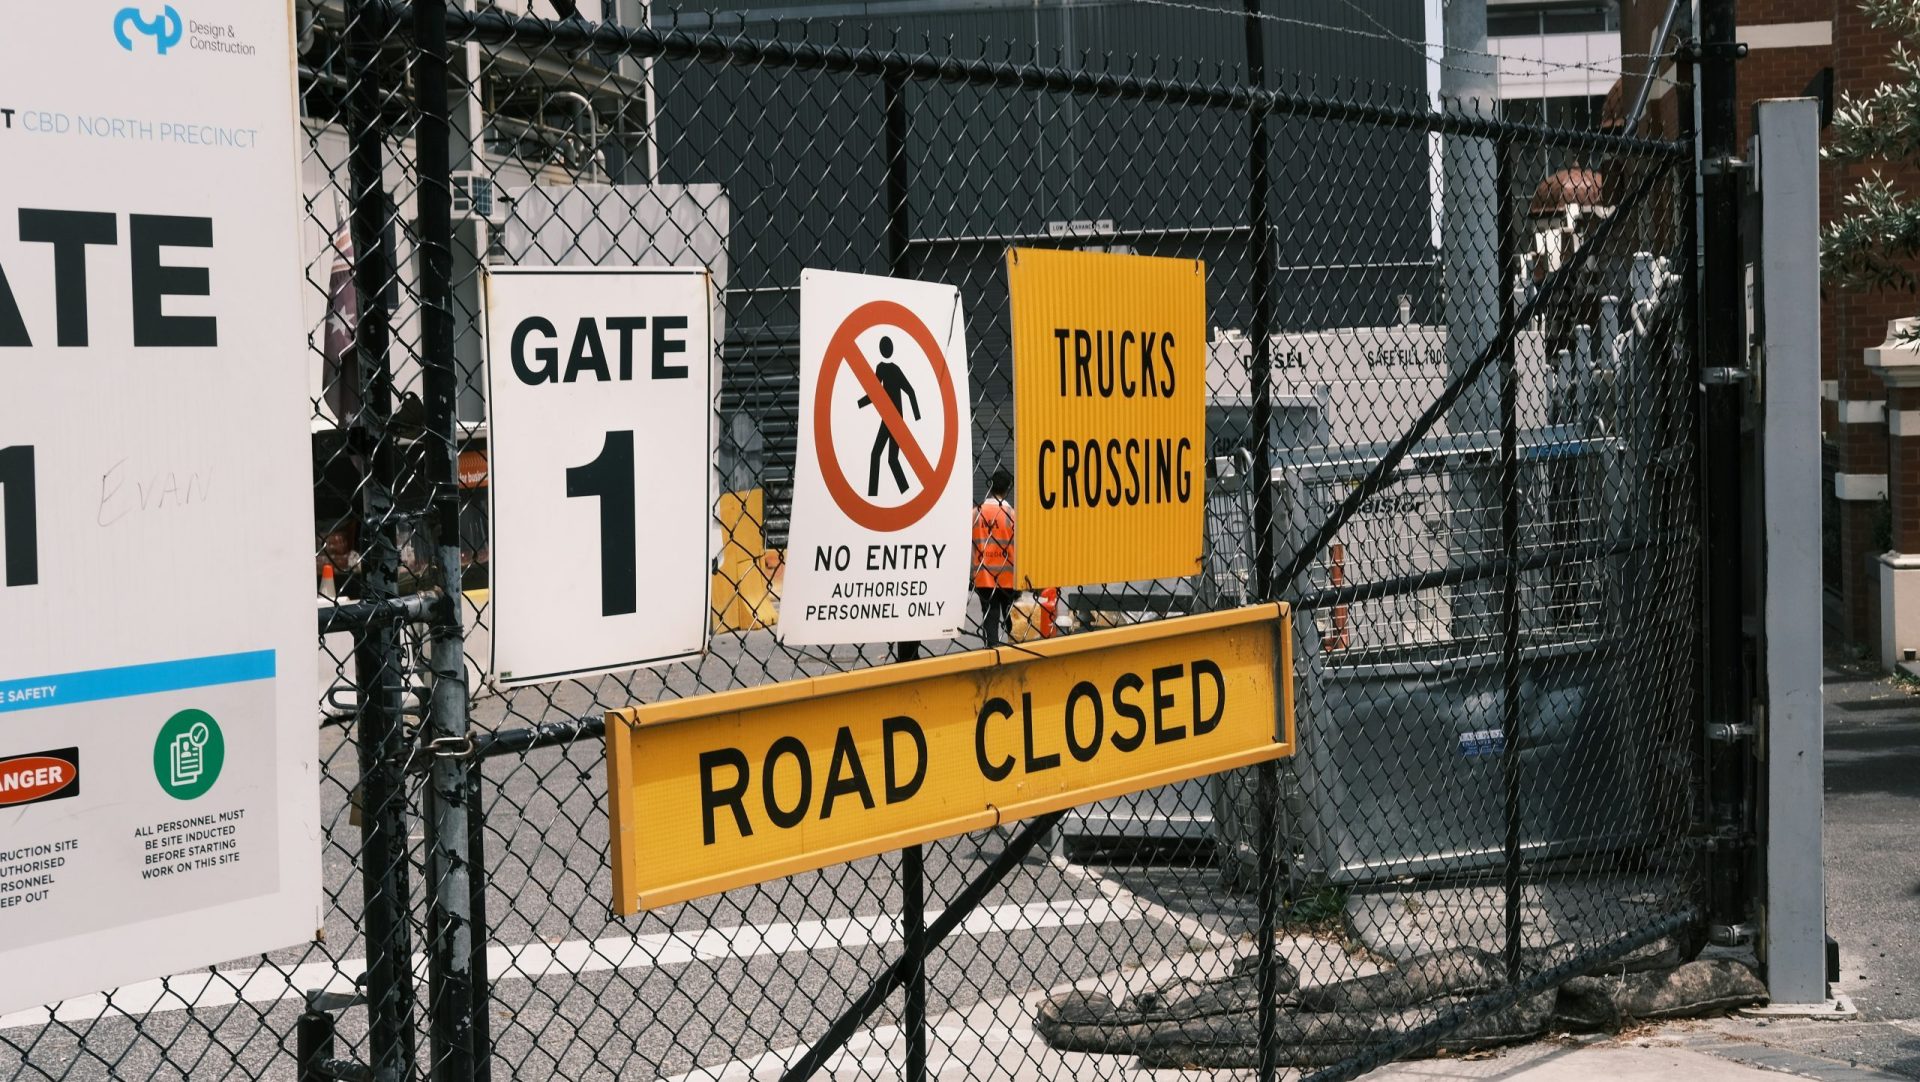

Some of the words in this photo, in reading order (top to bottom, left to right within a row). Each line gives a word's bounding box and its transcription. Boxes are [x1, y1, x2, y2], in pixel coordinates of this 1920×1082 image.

[189, 20, 225, 40] Design
[227, 25, 235, 38] &
[190, 36, 256, 56] Construction
[22, 110, 70, 133] CBD
[78, 116, 153, 141] NORTH
[160, 122, 258, 148] PRECINCT
[0, 207, 218, 348] TE
[510, 315, 689, 386] GATE
[1054, 328, 1176, 399] TRUCKS
[1038, 437, 1192, 510] CROSSING
[0, 444, 39, 587] 1
[565, 429, 637, 618] 1
[814, 545, 851, 572] NO
[866, 544, 947, 570] ENTRY
[832, 581, 928, 598] AUTHORISED
[805, 604, 899, 621] PERSONNEL
[908, 601, 945, 618] ONLY
[8, 685, 57, 702] SAFETY
[699, 716, 928, 846] ROAD
[974, 659, 1226, 782] CLOSED
[0, 766, 63, 793] NGER
[134, 826, 154, 838] ALL
[157, 815, 216, 834] PERSONNEL
[219, 809, 245, 822] MUST
[55, 839, 78, 852] SITE
[145, 839, 158, 850] BE
[161, 834, 183, 847] SITE
[186, 825, 236, 843] INDUCTED
[145, 848, 186, 865] BEFORE
[188, 839, 236, 856] STARTING
[142, 865, 174, 880] WORK
[177, 862, 192, 873] ON
[195, 857, 216, 869] THIS
[219, 852, 240, 865] SITE
[0, 874, 55, 893] RSONNEL
[0, 895, 22, 908] EEP
[25, 889, 49, 903] OUT
